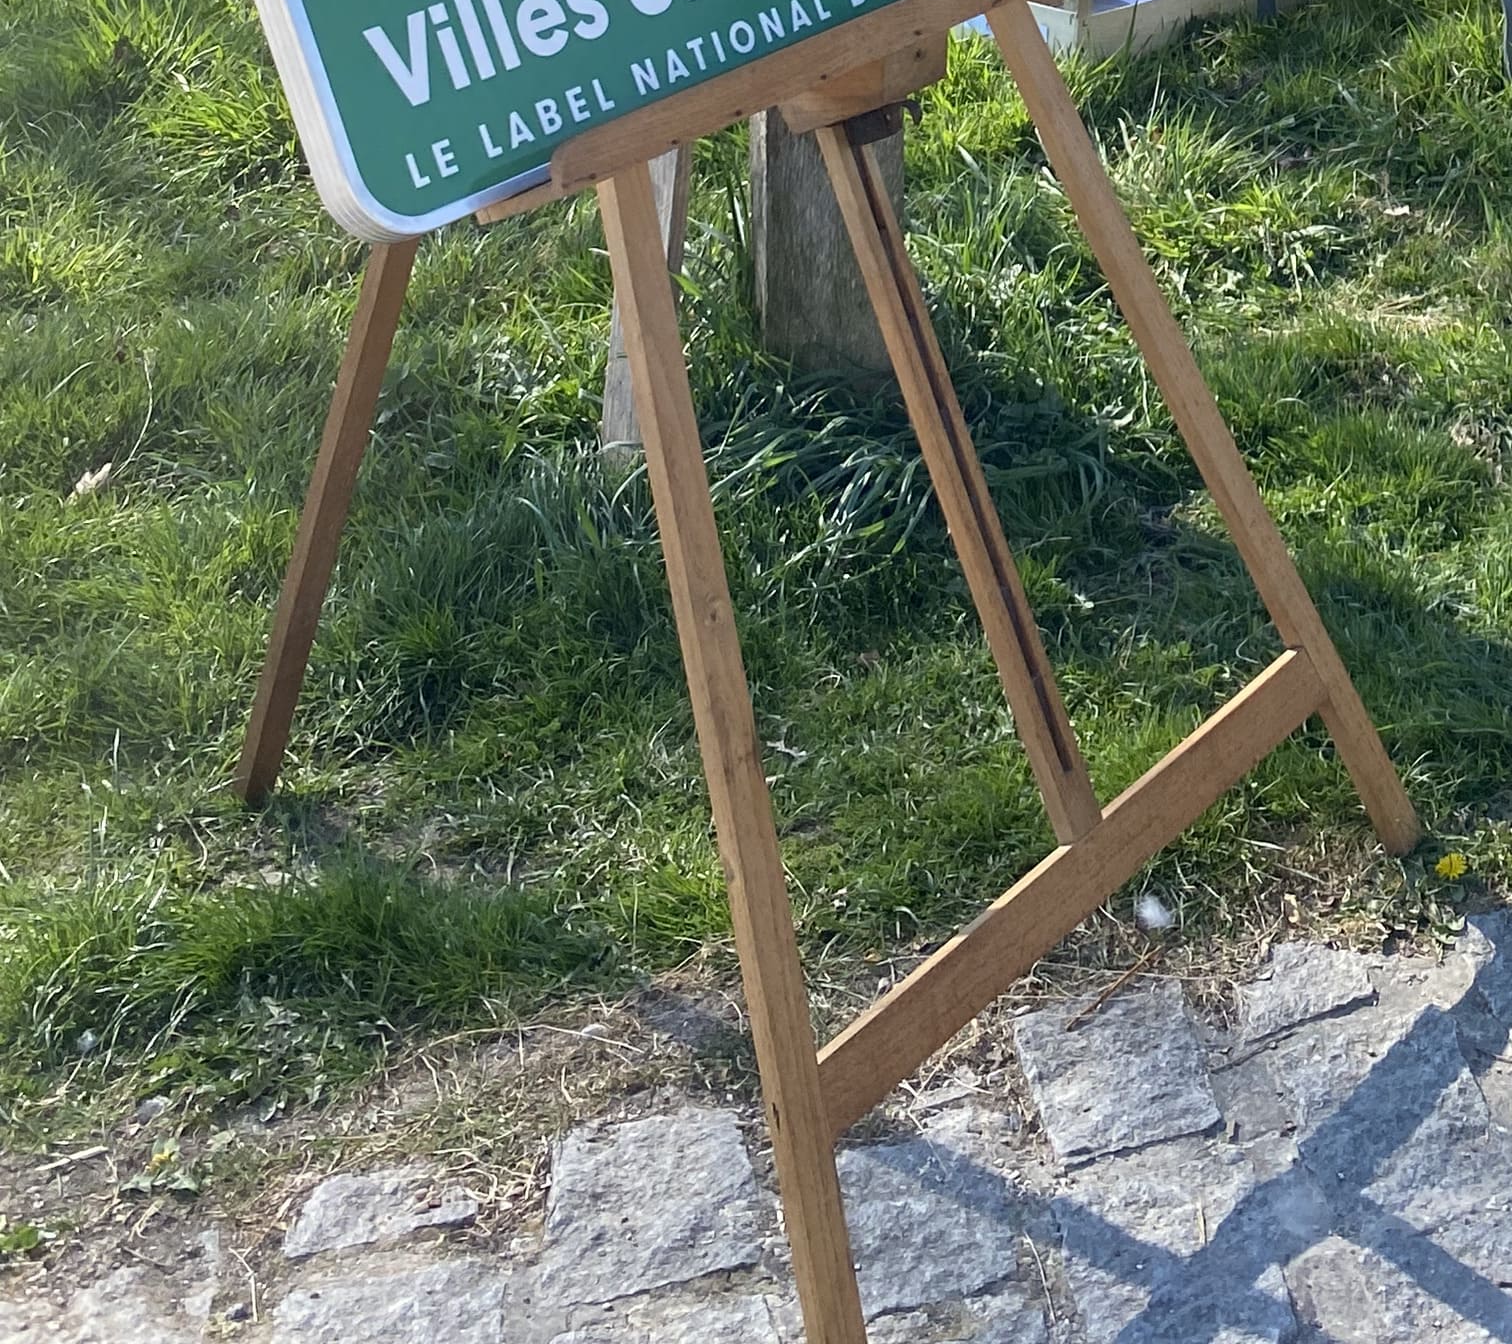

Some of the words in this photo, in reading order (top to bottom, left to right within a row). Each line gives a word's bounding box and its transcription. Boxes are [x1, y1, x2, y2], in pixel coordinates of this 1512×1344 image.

[406, 138, 459, 191] LE
[479, 86, 616, 160] LABEL
[631, 1, 832, 94] NATIONAL
